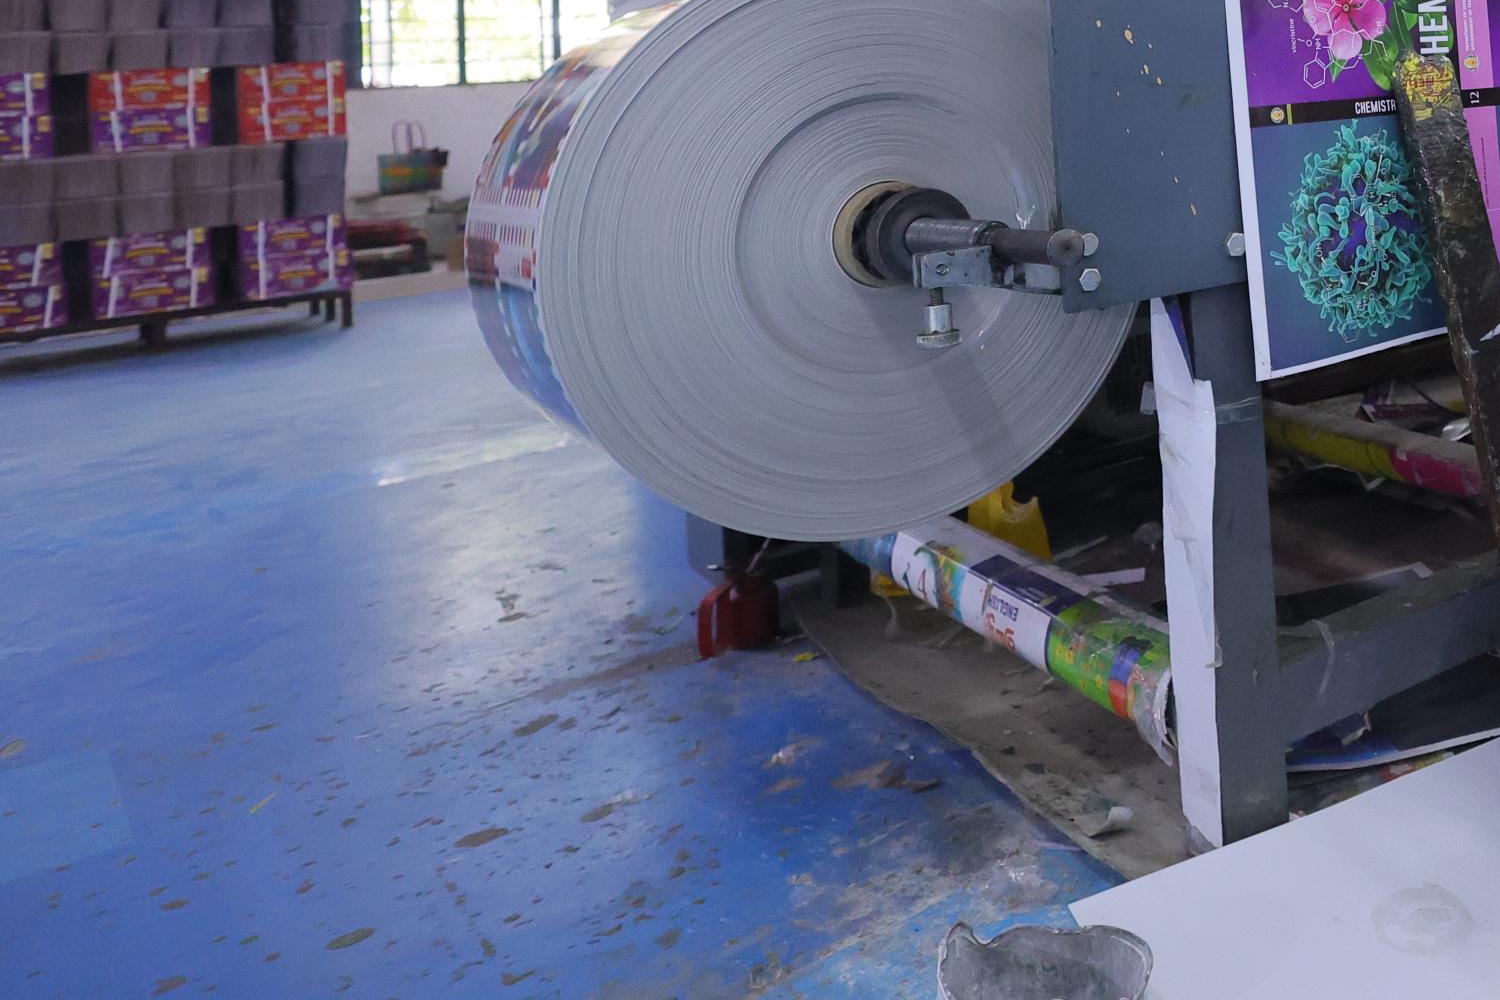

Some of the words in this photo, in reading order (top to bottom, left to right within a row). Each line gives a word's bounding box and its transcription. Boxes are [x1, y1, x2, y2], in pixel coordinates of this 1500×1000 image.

[1288, 18, 1297, 53] vincristine
[1469, 91, 1480, 105] 12
[1355, 99, 1397, 115] CHEMISTR
